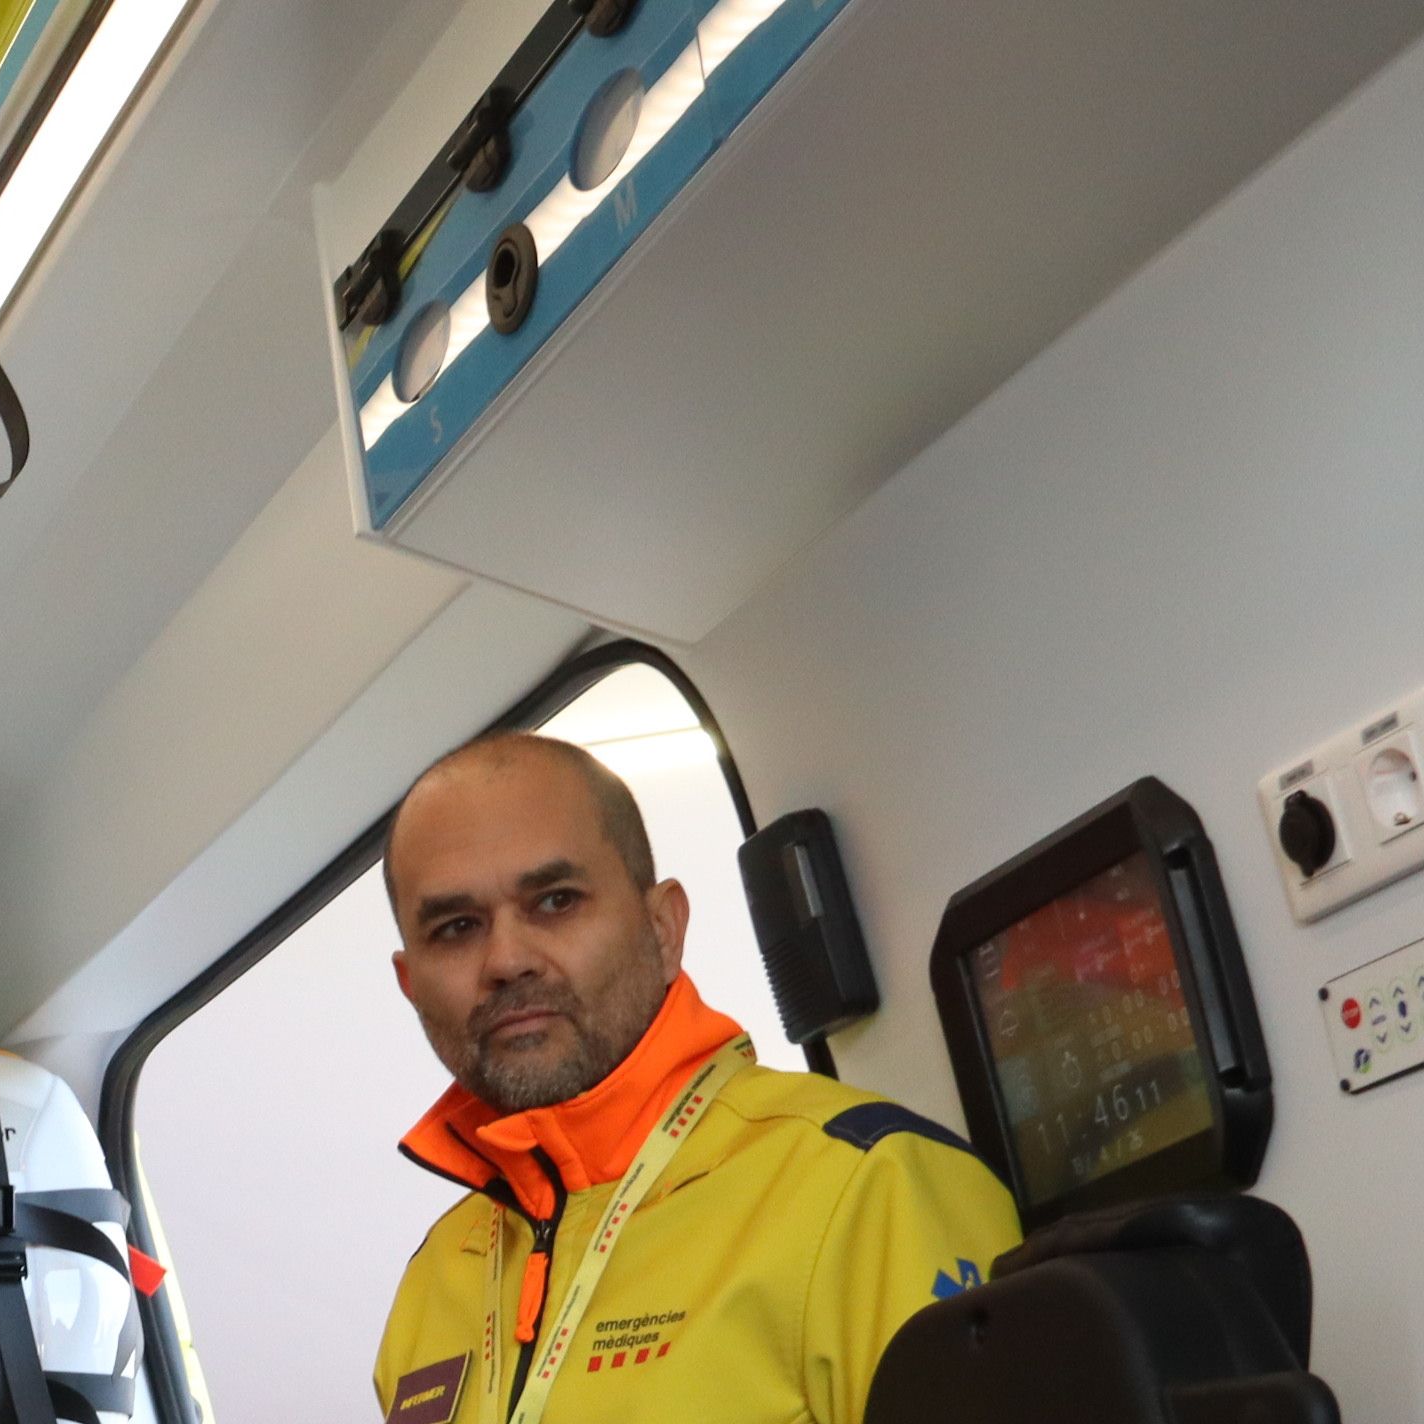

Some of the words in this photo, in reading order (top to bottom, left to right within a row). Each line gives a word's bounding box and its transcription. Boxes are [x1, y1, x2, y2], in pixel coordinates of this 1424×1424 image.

[613, 179, 639, 233] M
[429, 407, 442, 444] S
[595, 1310, 687, 1332] emergències
[592, 1332, 660, 1351] mèdiques
